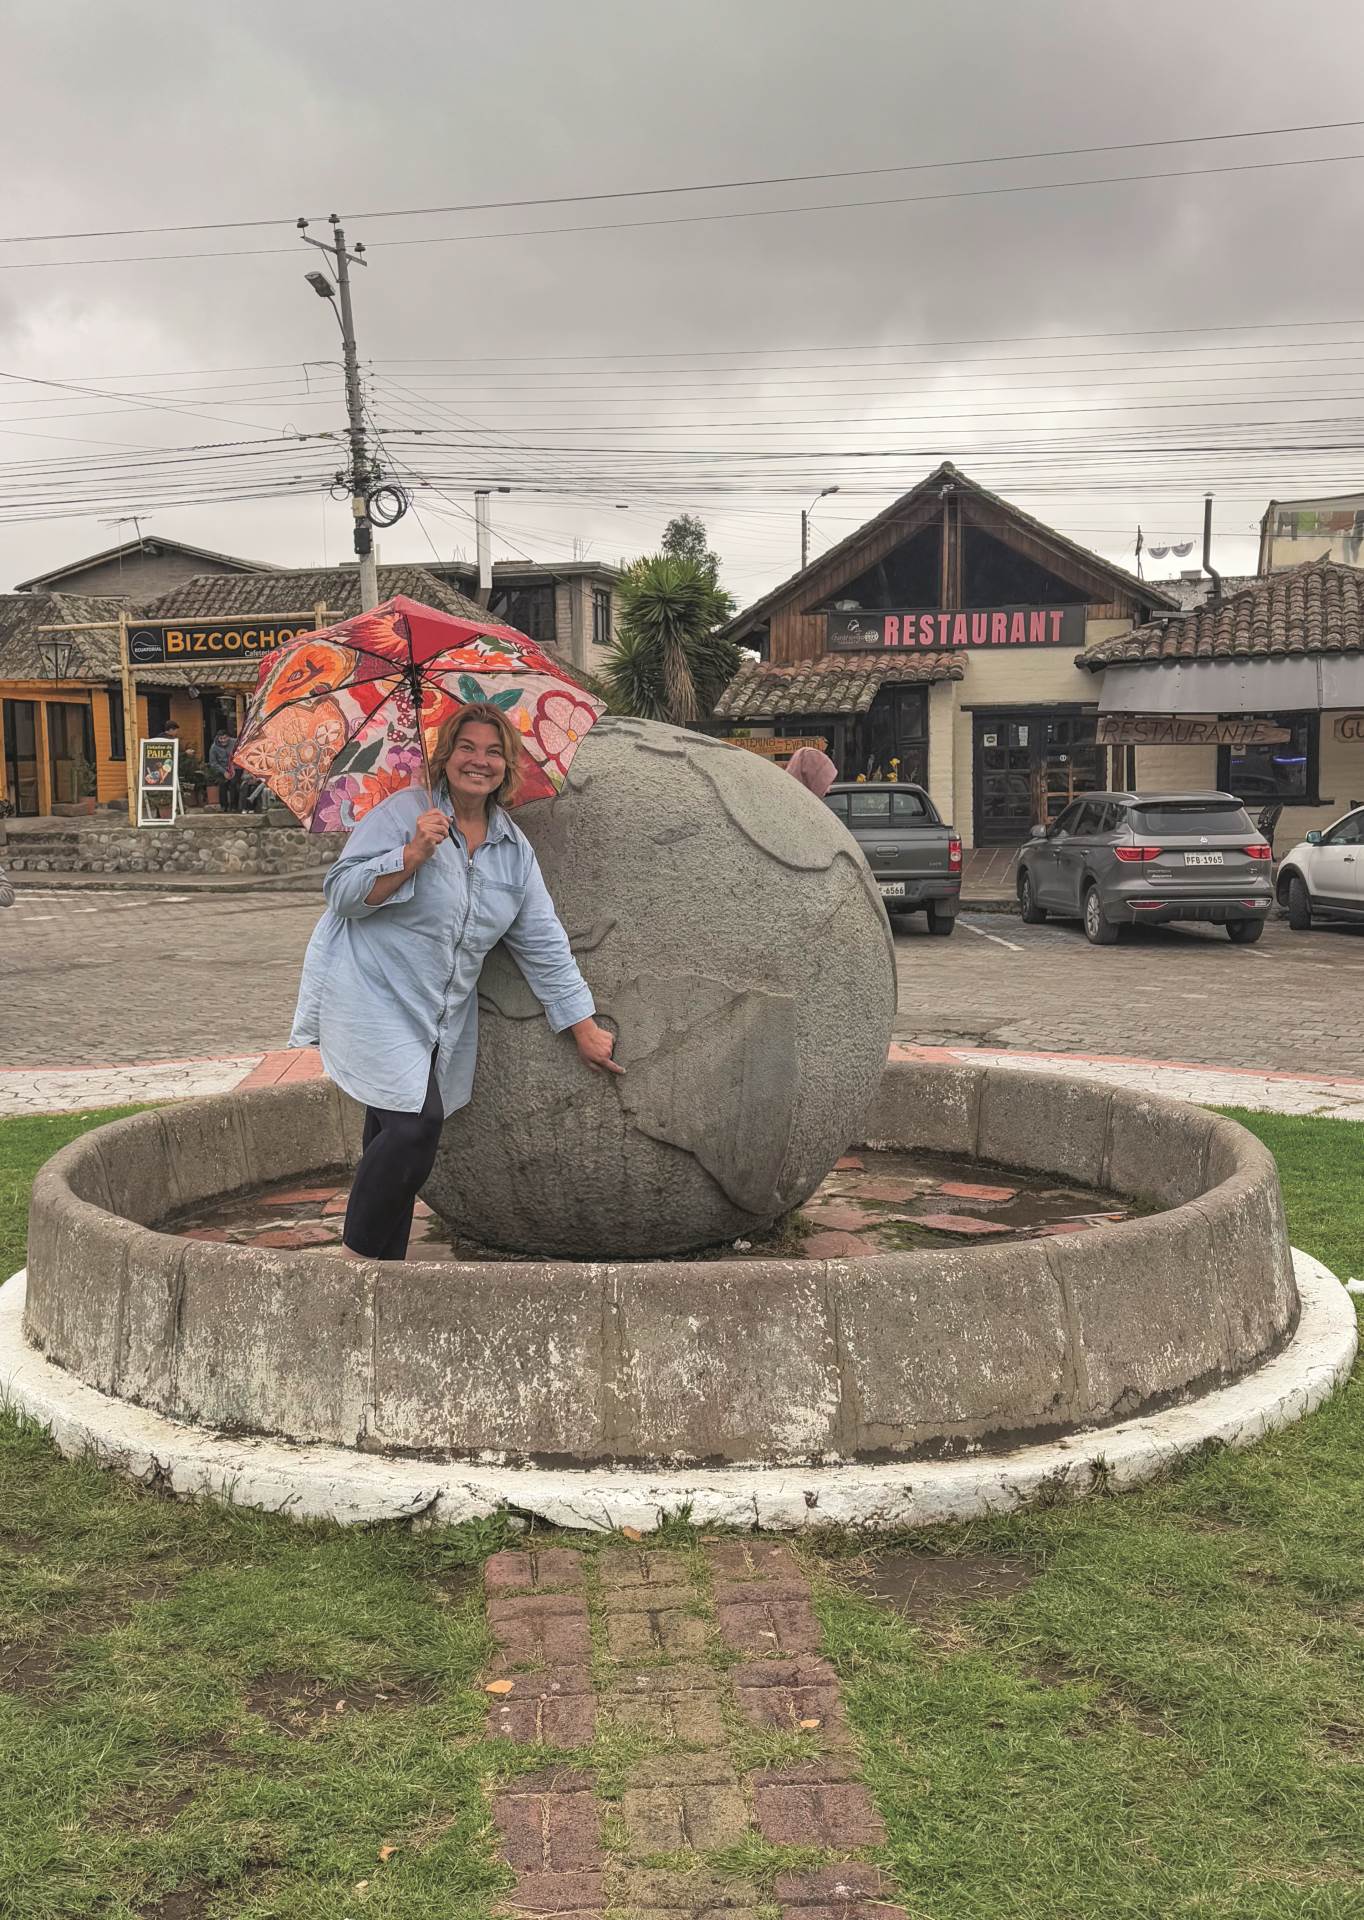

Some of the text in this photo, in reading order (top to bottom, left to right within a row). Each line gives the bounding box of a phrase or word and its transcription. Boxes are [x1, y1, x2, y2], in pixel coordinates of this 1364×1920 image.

[884, 611, 1064, 646] RESTAURANT
[1102, 720, 1268, 744] RESTAURANTE
[147, 750, 172, 759] PAILA
